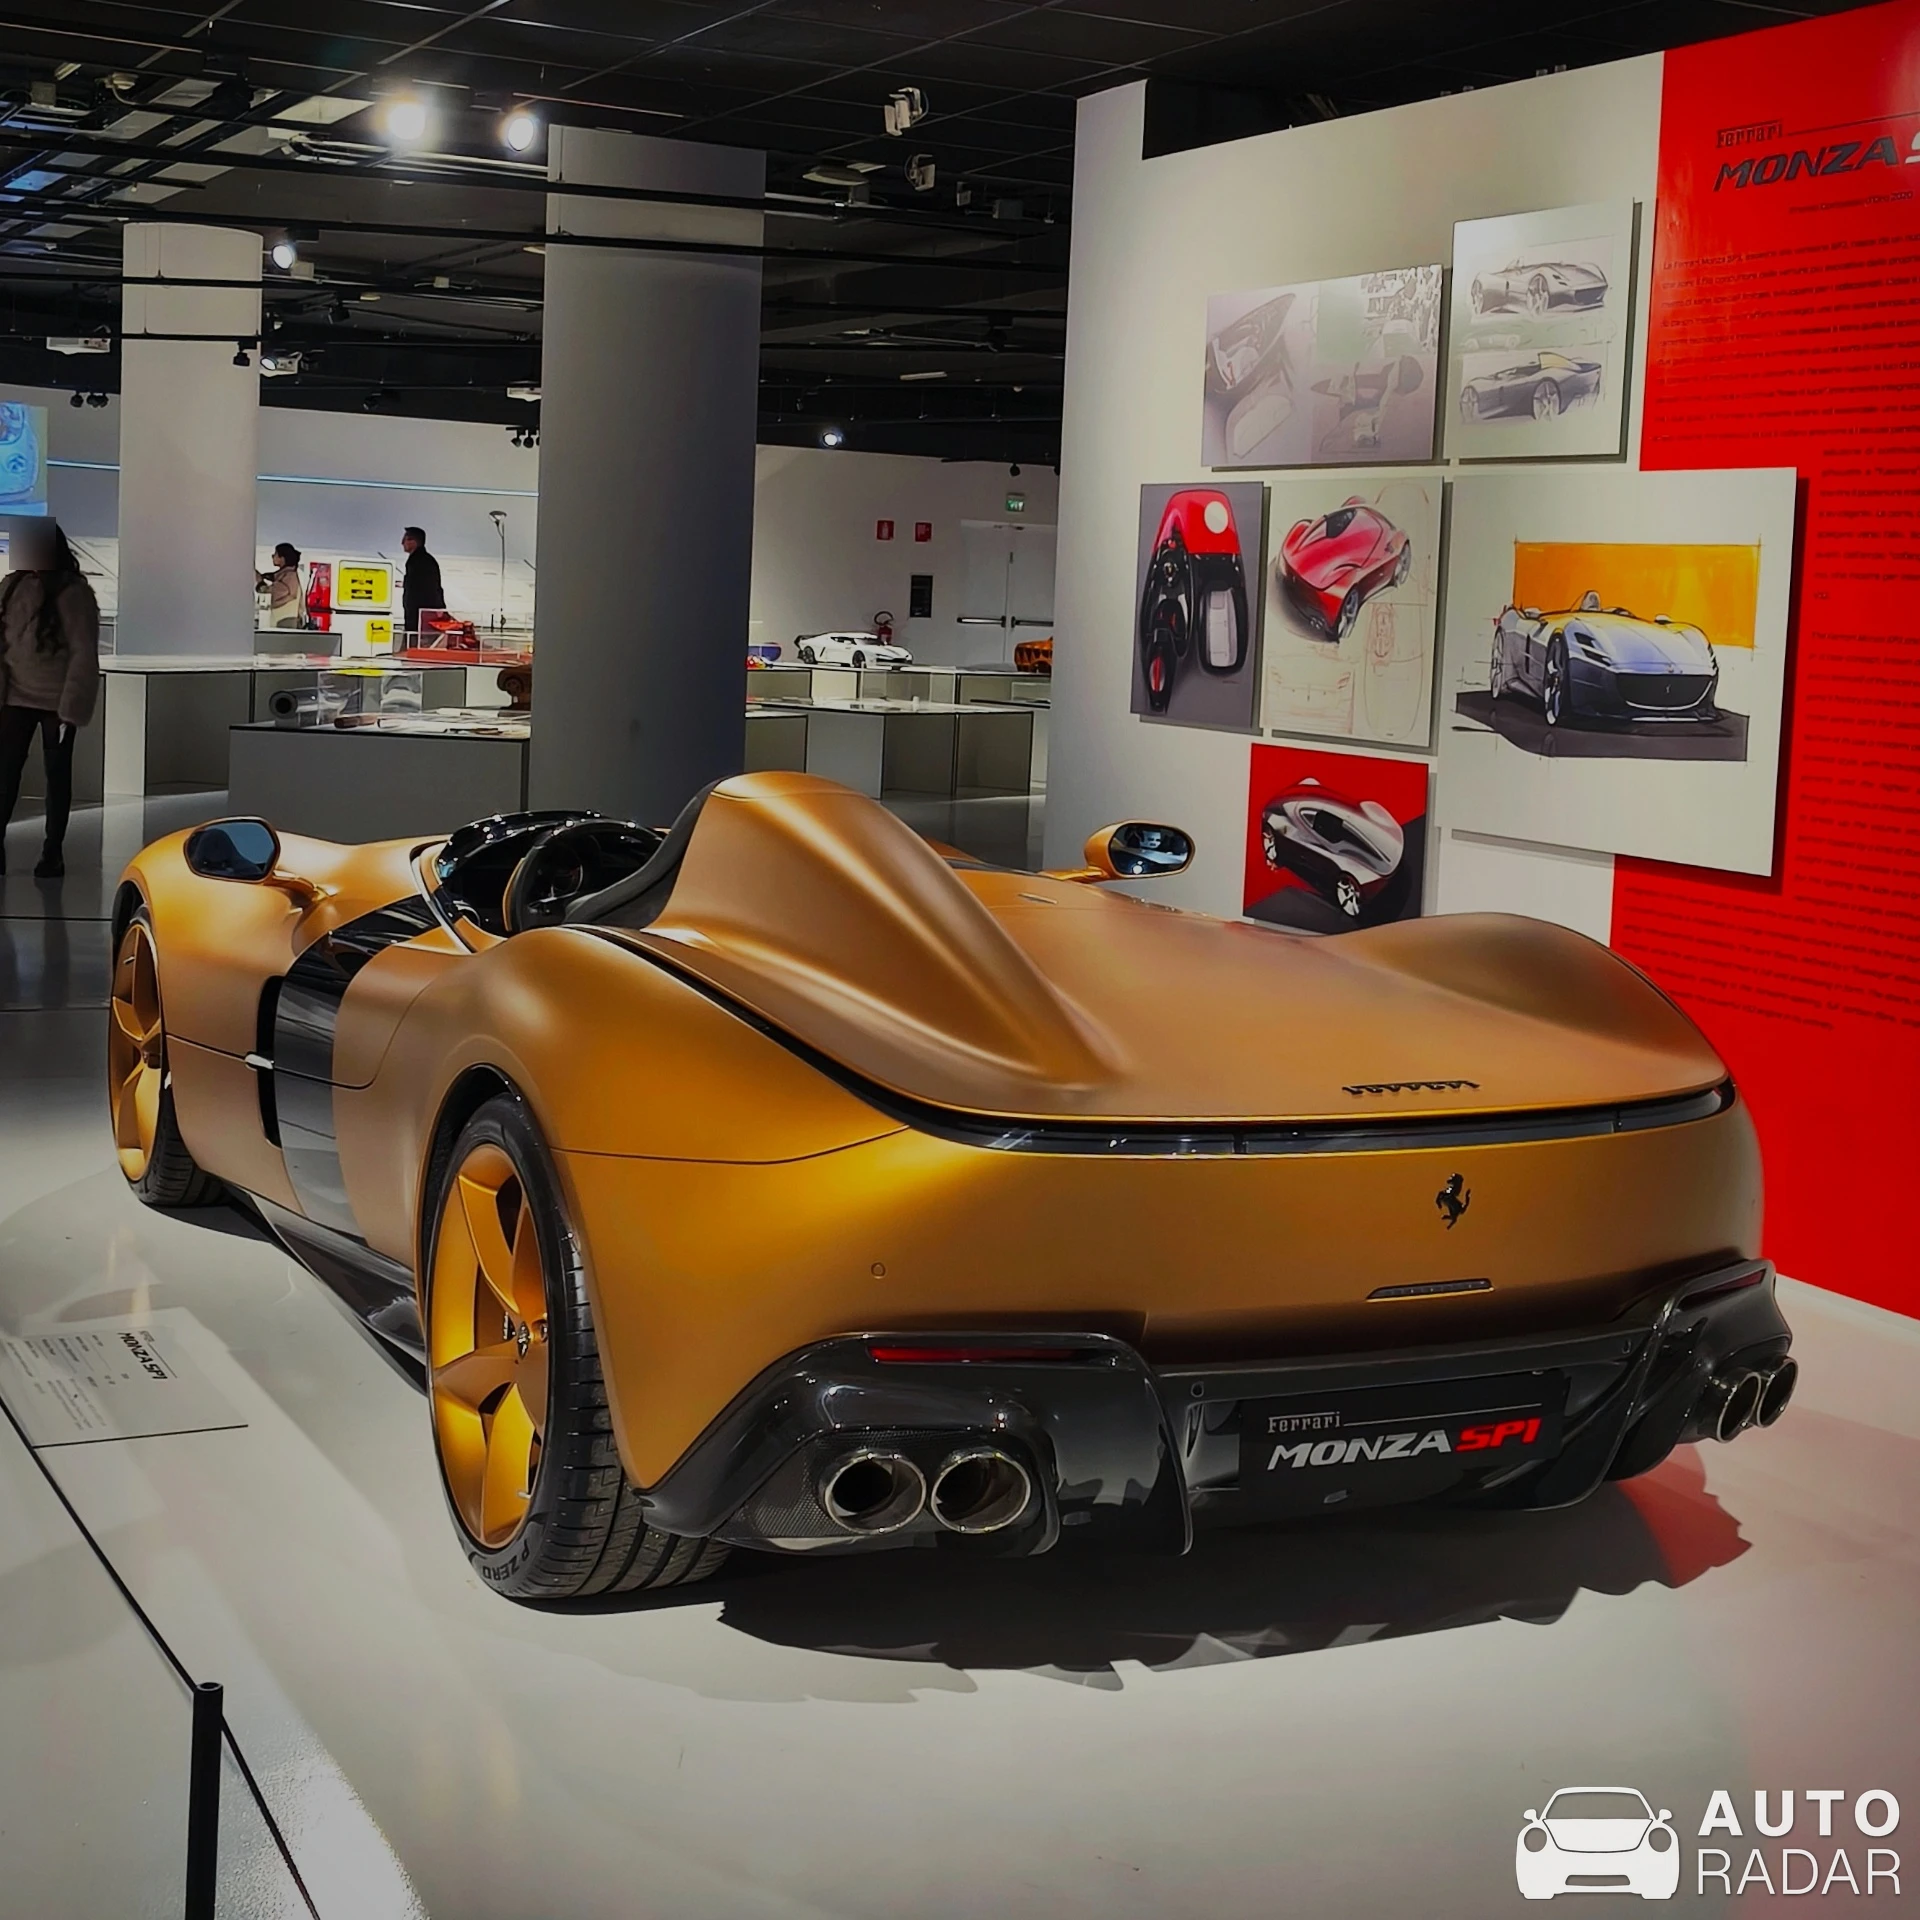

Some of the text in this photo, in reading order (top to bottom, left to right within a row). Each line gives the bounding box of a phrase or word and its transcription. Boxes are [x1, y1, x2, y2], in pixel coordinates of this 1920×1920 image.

[1717, 119, 1783, 148] Ferrari
[1713, 136, 1899, 191] MONZA
[1267, 1411, 1341, 1434] Ferrari
[1267, 1430, 1452, 1470] MONZA
